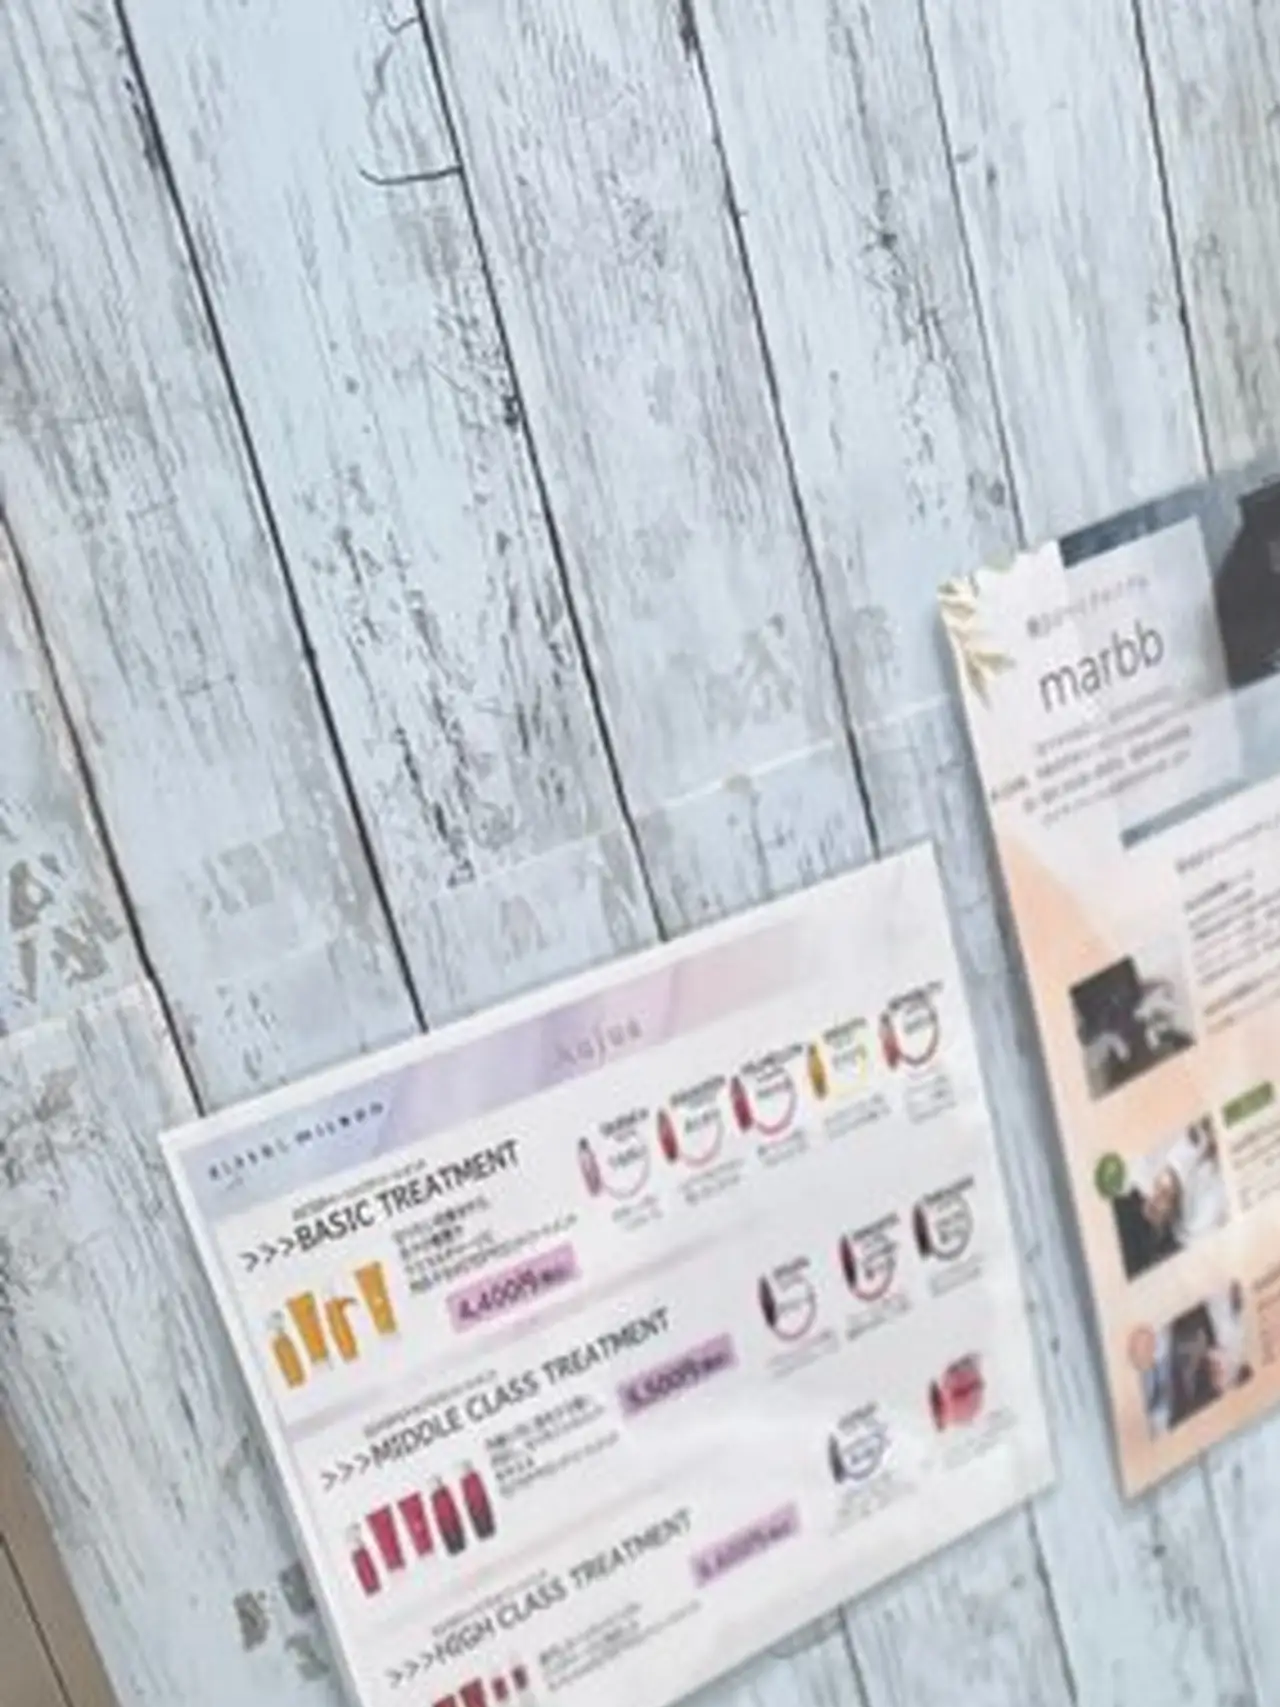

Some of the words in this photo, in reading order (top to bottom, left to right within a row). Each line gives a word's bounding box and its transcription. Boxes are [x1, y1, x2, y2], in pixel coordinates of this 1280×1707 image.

[1039, 619, 1166, 712] marbb
[294, 1201, 376, 1254] BASIC
[377, 1138, 524, 1219] TREATMENT
[368, 1407, 467, 1468] MIDDLE
[463, 1371, 542, 1423] CLASS
[542, 1309, 673, 1382] TREATMENT
[492, 1578, 571, 1632] CLASS
[569, 1510, 693, 1585] TREATMENT
